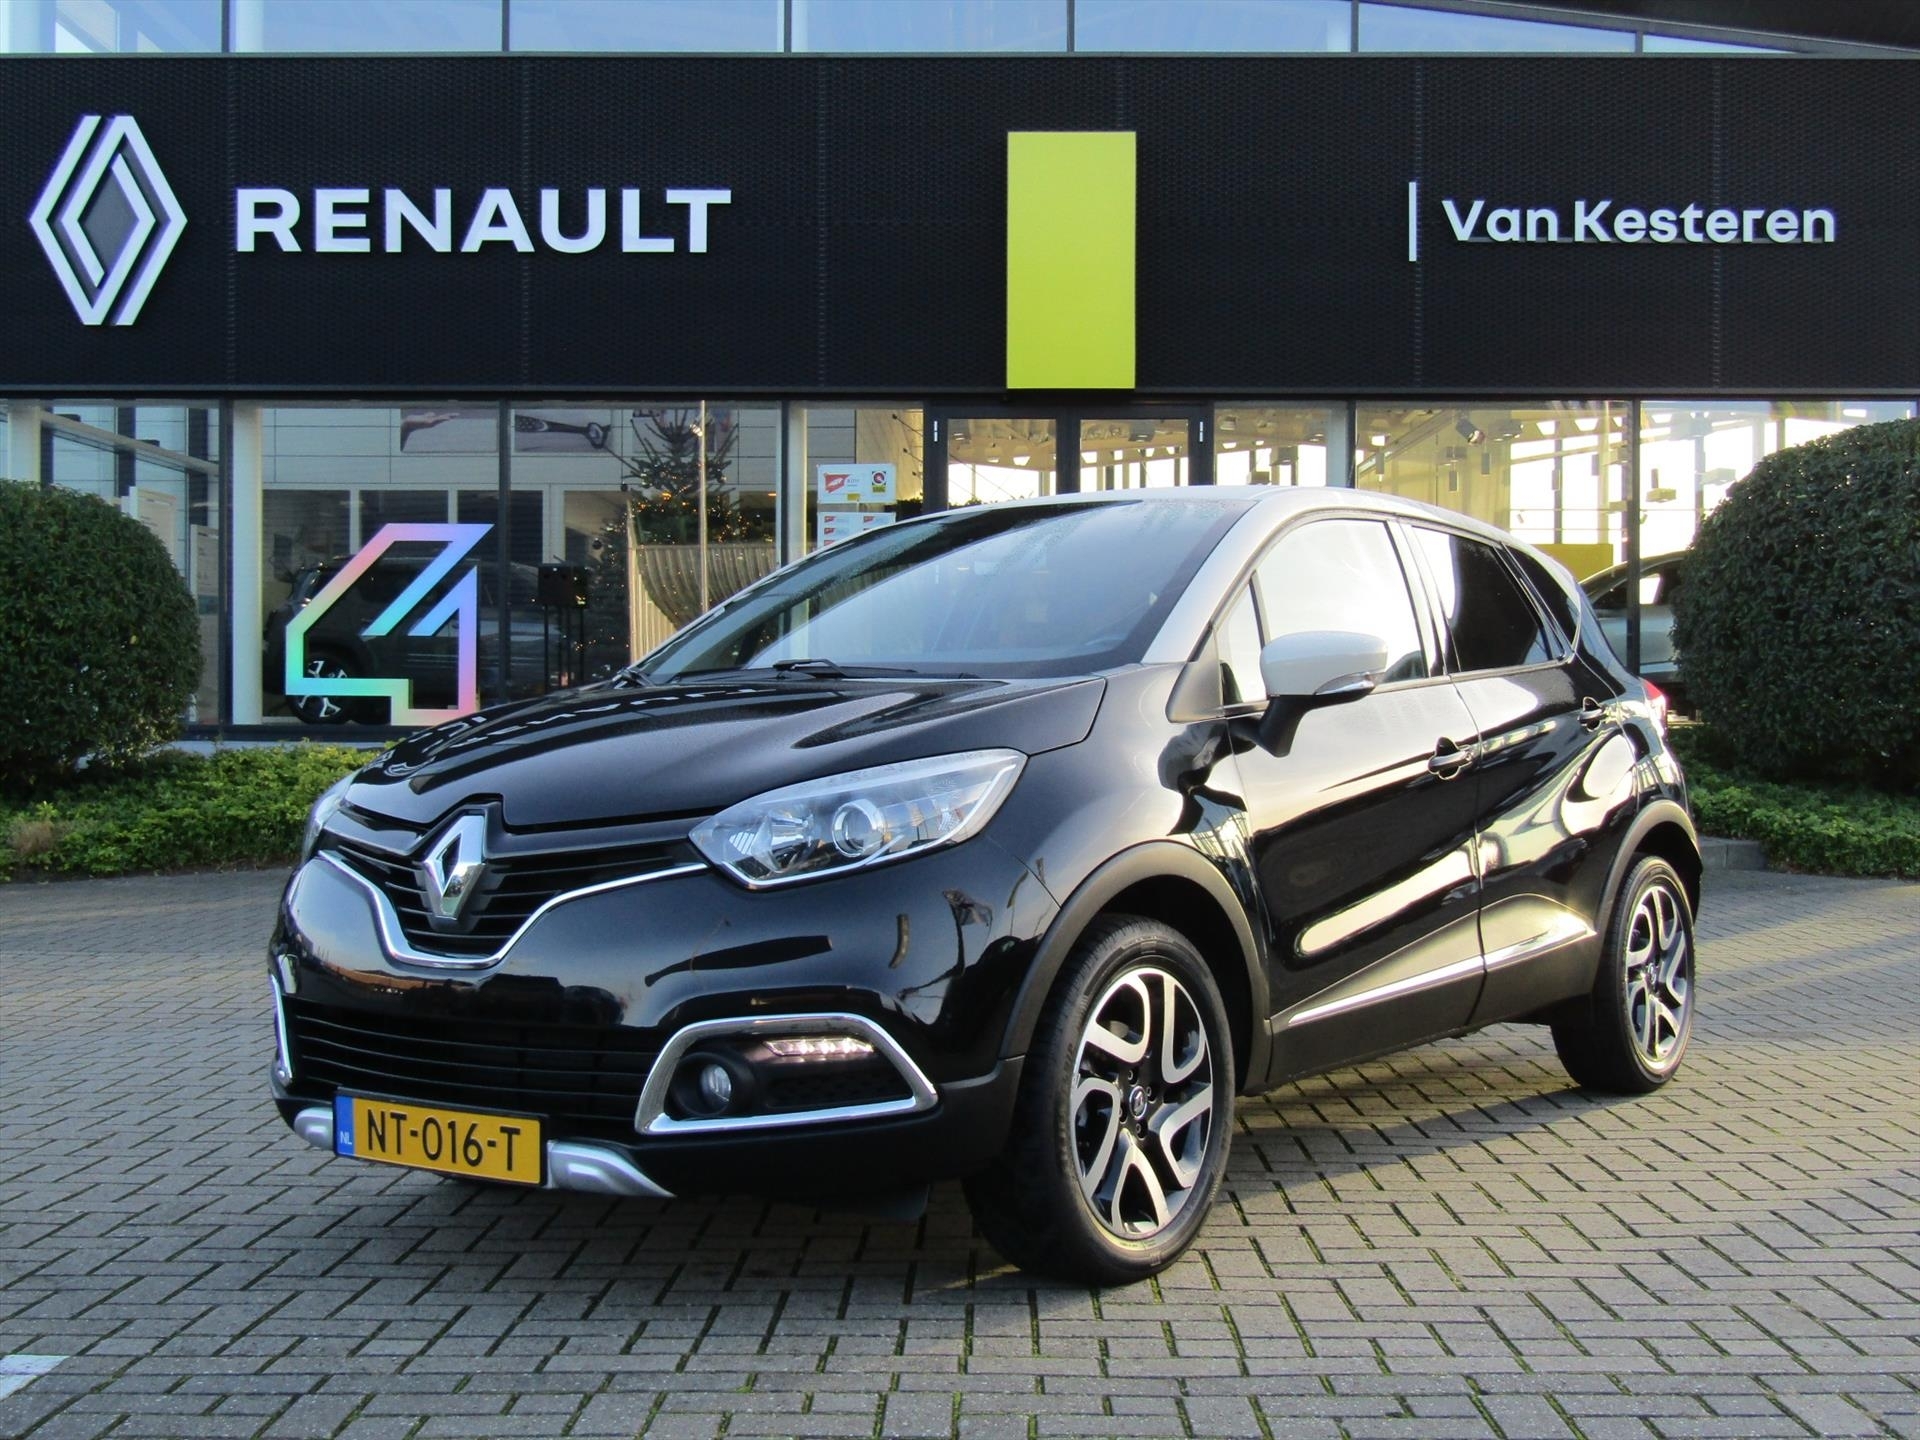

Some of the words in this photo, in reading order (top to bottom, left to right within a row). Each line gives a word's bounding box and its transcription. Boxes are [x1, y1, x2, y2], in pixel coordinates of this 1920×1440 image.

[236, 188, 732, 253] RENAULT
[1442, 200, 1559, 242] Van
[1574, 200, 1835, 243] Kesteren
[339, 1131, 353, 1146] NL
[367, 1109, 521, 1171] NT-016-T
